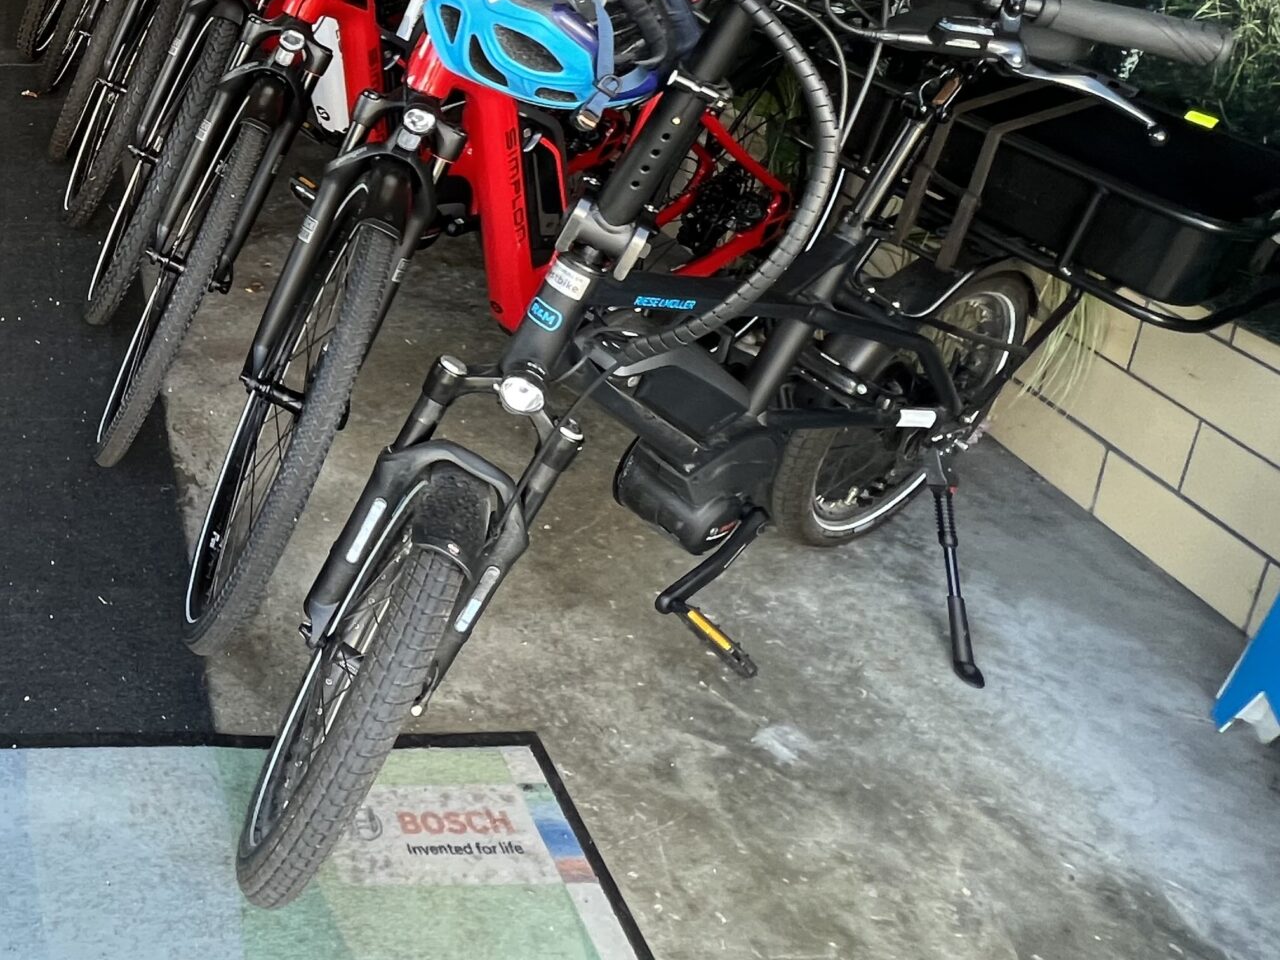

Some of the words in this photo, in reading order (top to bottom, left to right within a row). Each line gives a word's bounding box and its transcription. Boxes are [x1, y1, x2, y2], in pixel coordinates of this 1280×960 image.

[505, 126, 527, 244] SIMPLON
[531, 302, 556, 325] R&M
[395, 807, 516, 836] BOSCH
[406, 842, 473, 856] Invented
[475, 842, 497, 855] for
[498, 841, 525, 855] life
